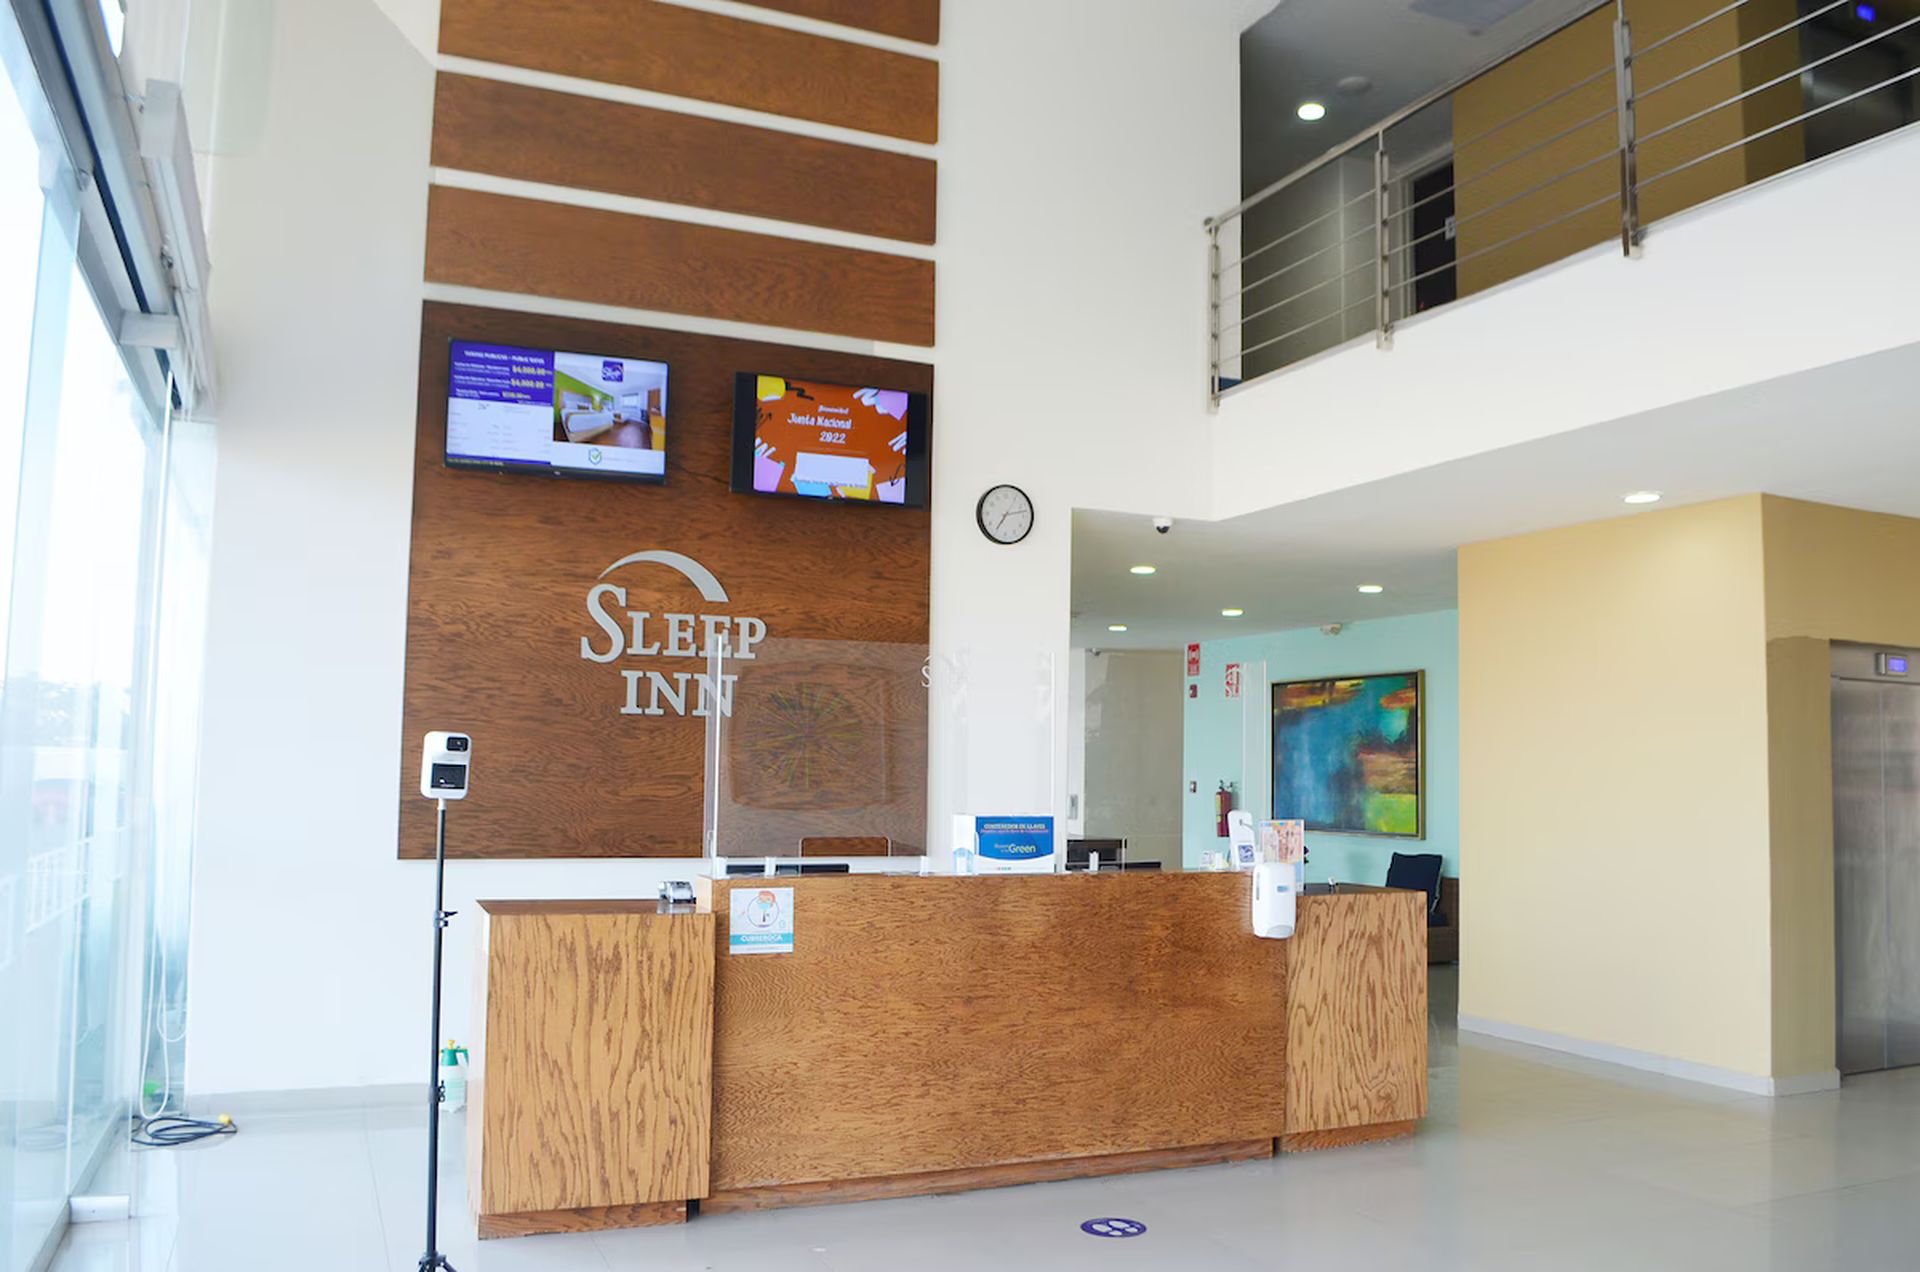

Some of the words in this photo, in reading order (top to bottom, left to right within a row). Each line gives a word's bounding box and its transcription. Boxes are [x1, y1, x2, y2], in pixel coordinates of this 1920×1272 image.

[788, 413, 815, 426] Junta
[819, 431, 847, 444] 2022
[580, 584, 768, 664] SLEEP
[620, 670, 738, 717] INN
[1008, 843, 1035, 853] Green
